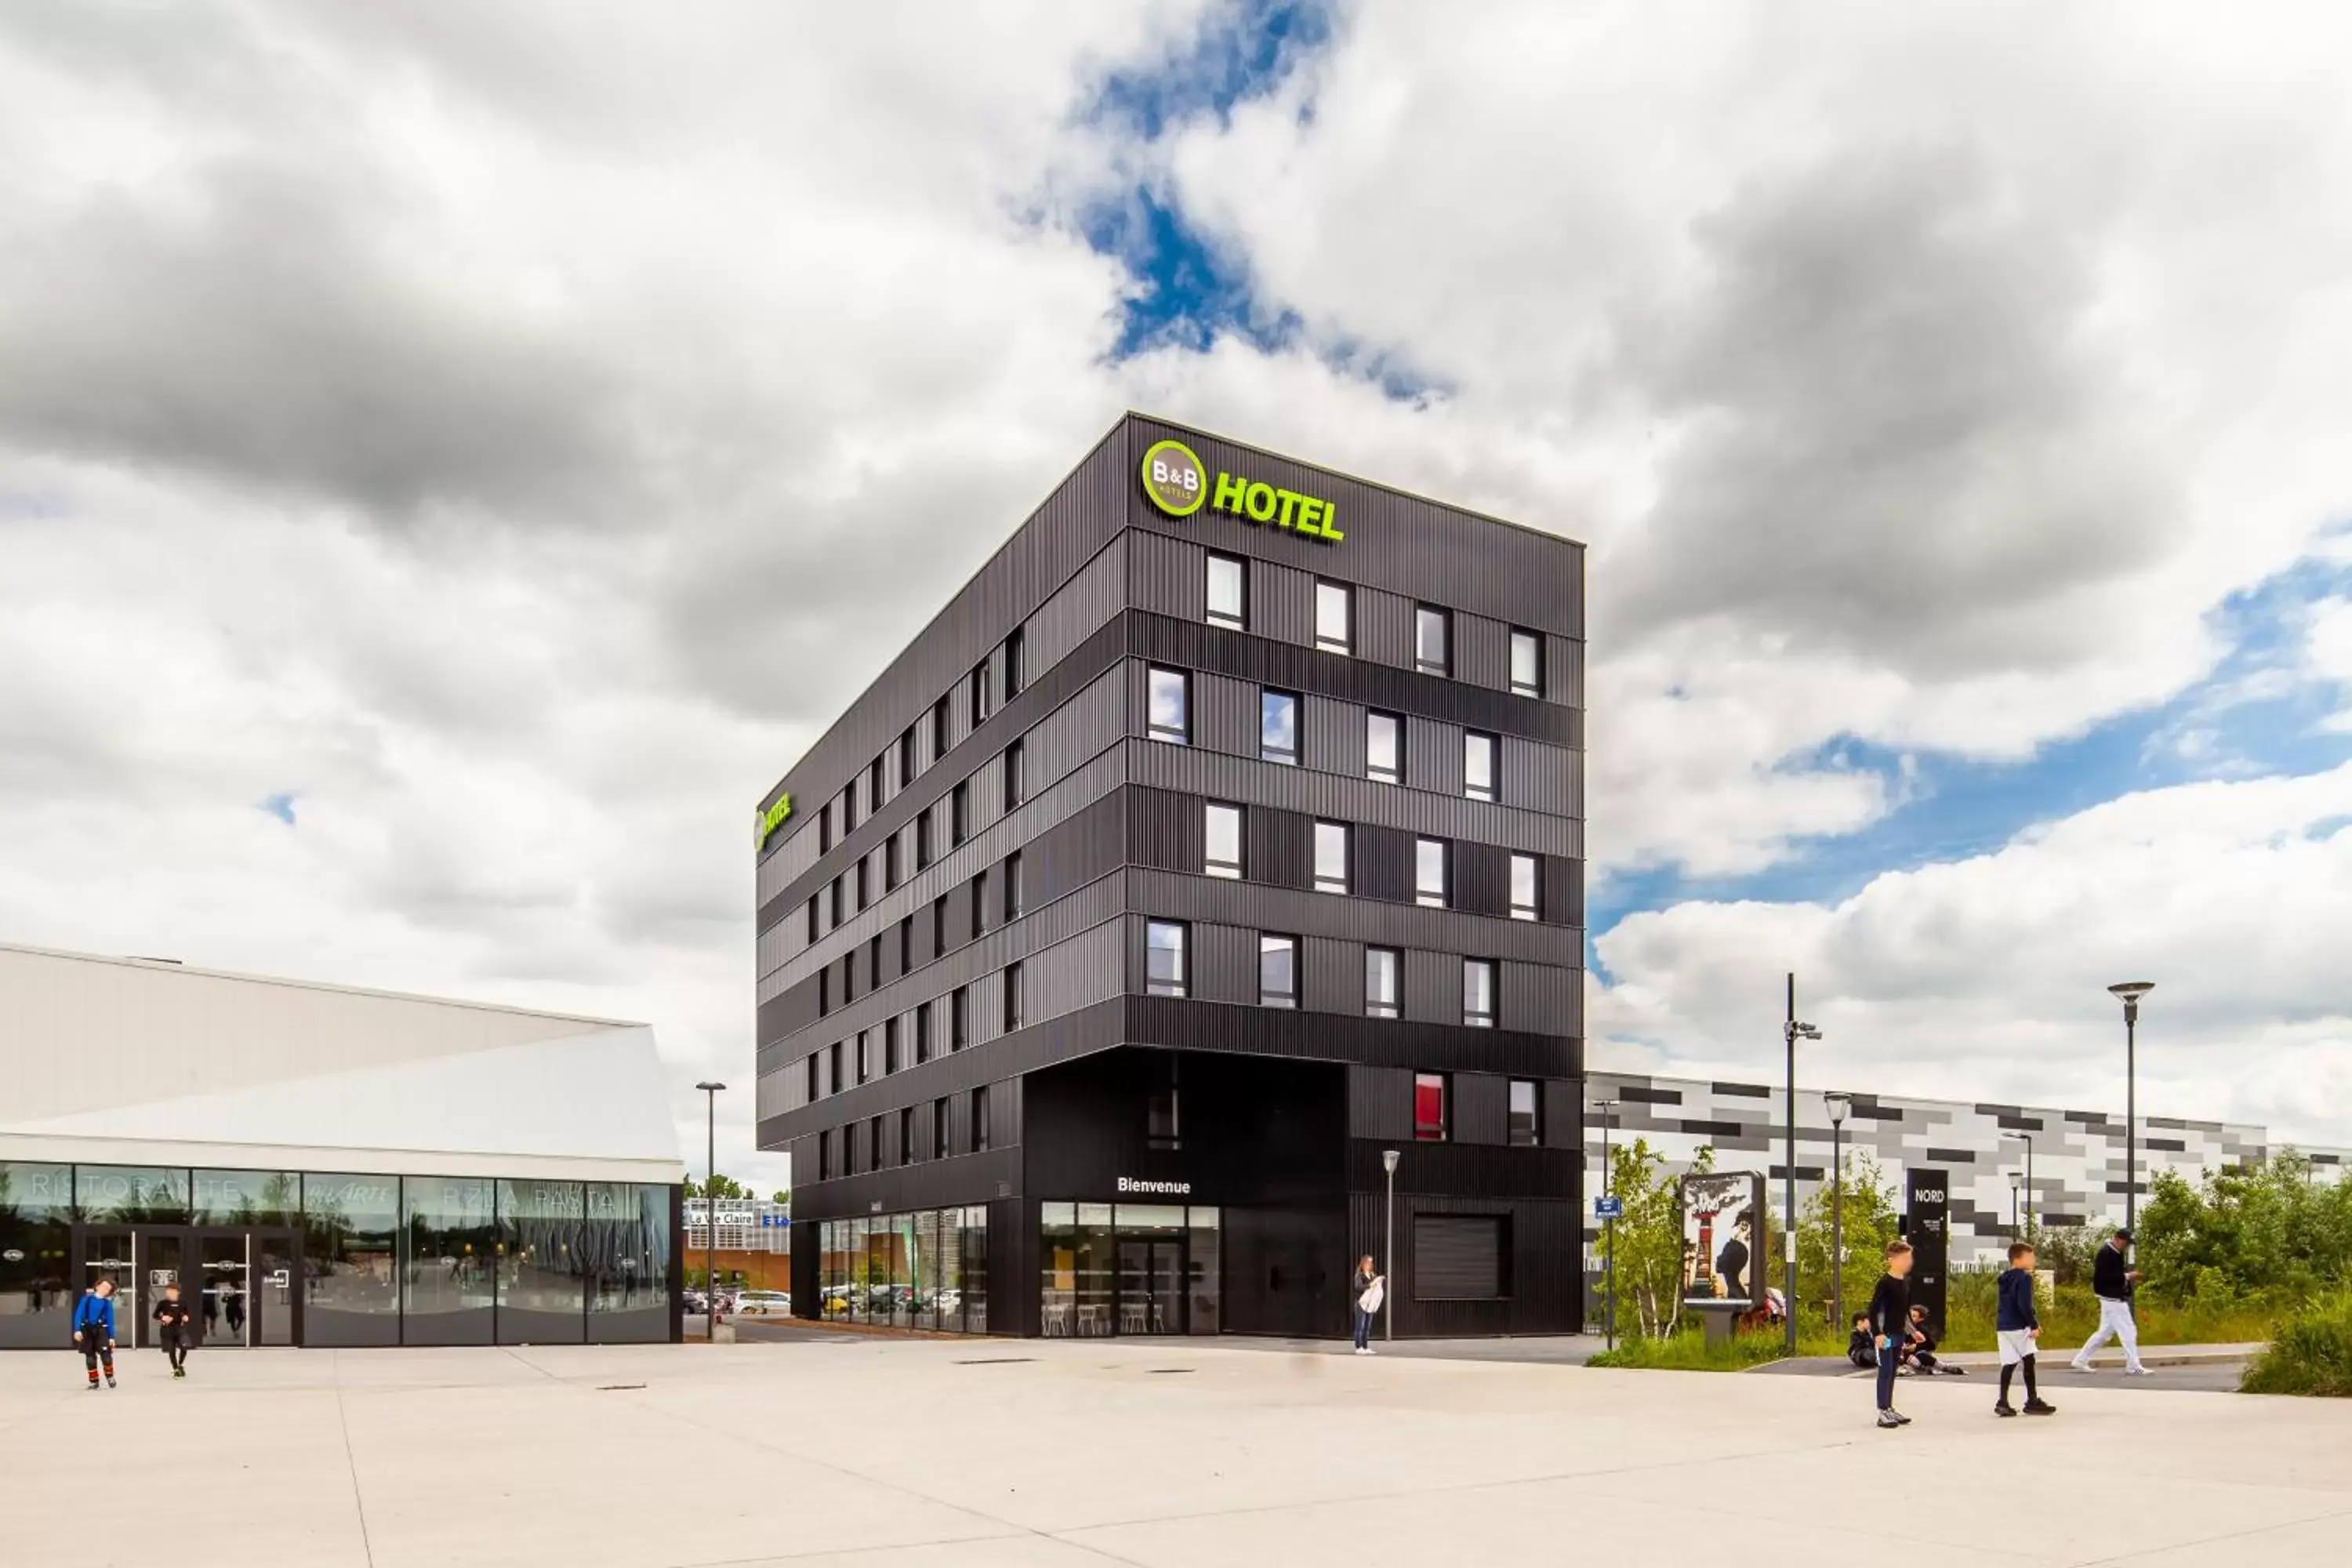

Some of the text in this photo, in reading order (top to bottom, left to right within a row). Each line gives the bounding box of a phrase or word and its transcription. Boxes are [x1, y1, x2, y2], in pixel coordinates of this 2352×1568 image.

[1153, 460, 1199, 492] B&B
[1213, 472, 1344, 541] HOTEL
[31, 1173, 241, 1202] RISTORANTE
[1117, 1177, 1191, 1194] Bienvenue
[1915, 1189, 1945, 1203] NORD
[690, 1213, 752, 1224] La Ve Claire
